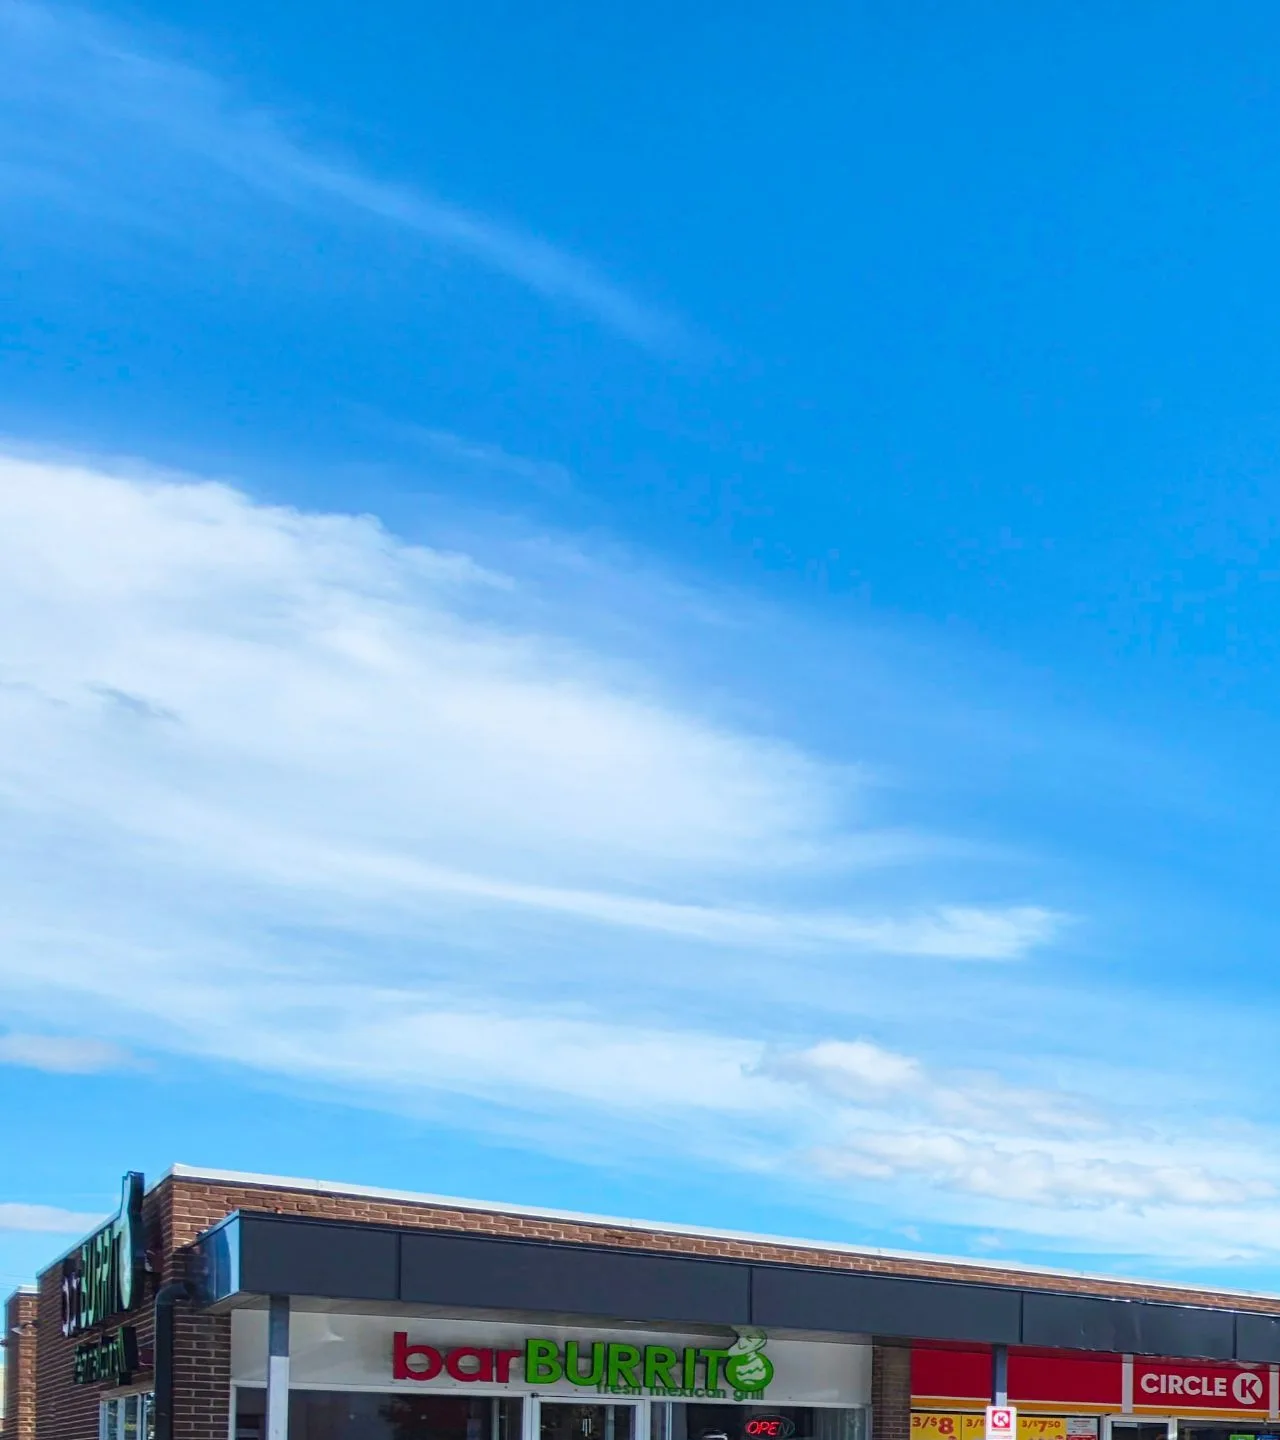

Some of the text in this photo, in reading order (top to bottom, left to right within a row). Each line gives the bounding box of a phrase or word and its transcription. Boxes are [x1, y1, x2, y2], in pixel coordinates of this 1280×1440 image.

[1140, 1373, 1263, 1404] CIRCLE K
[746, 1421, 791, 1437] OPEN
[911, 1416, 955, 1435] 3/$8
